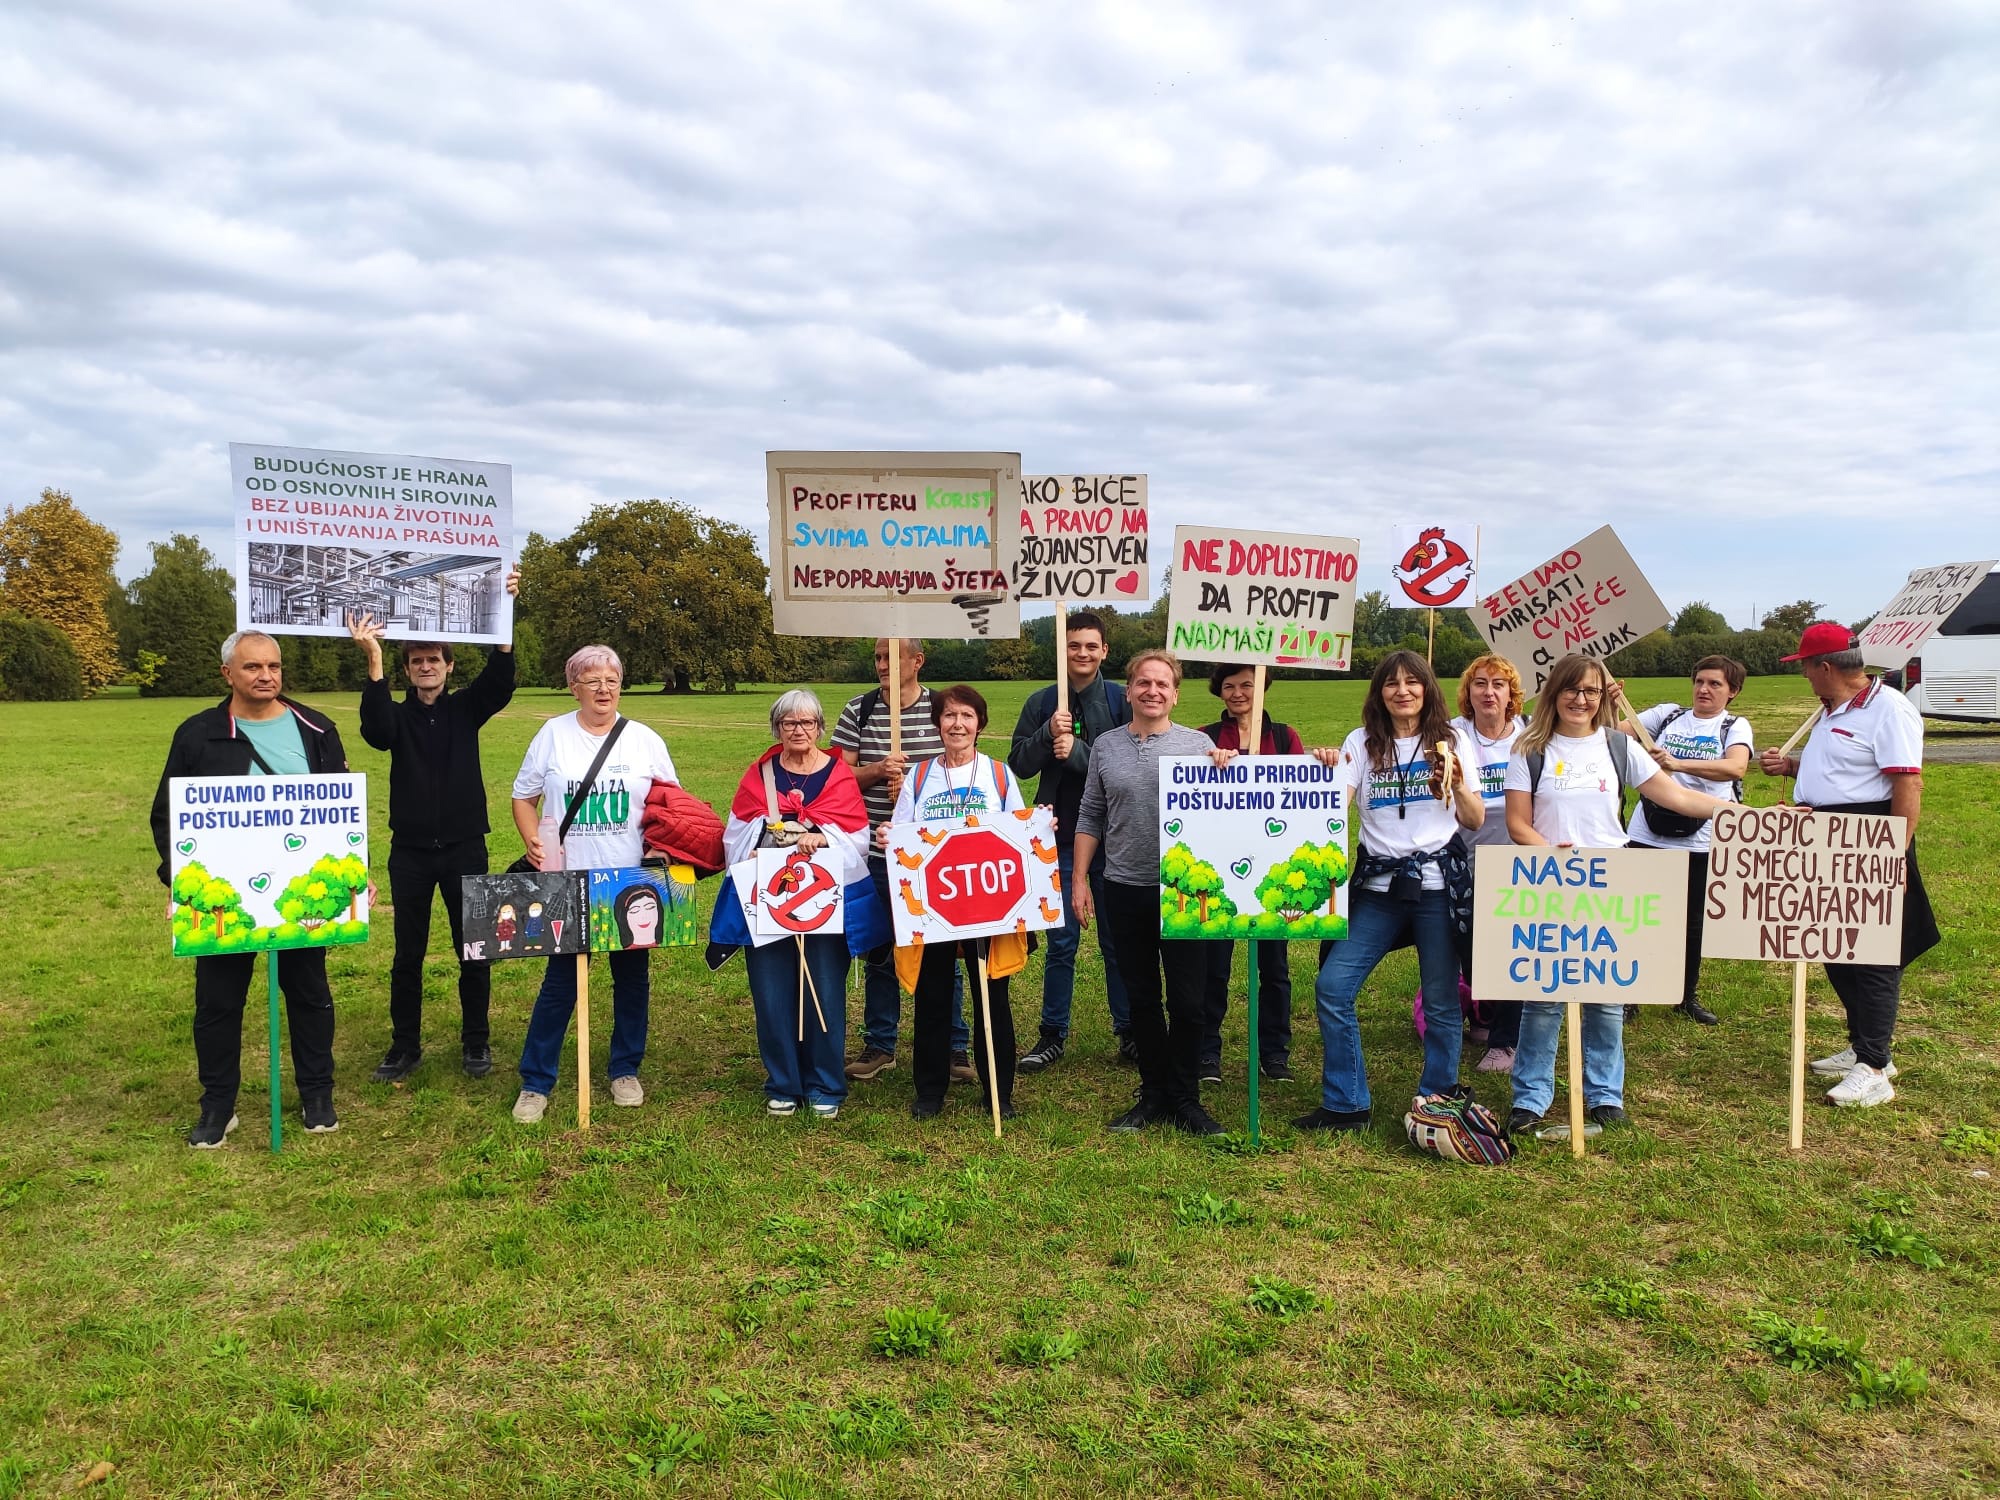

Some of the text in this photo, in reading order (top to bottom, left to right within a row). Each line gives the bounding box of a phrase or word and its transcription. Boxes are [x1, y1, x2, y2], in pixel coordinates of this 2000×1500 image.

[254, 456, 488, 488] BUDUĆNOST JE HRANA
[245, 477, 497, 508] OD OSNOVNIH SIROVINA
[793, 485, 995, 517] PROFITERU KORIST,
[1020, 475, 1139, 505] AKO BIĆE
[251, 498, 494, 528] BEZ UBIJANJA ŽIVOTINJA
[1020, 507, 1148, 535] A PRAVO NA
[246, 518, 500, 548] I UNIŠTAVANJA PRAŠUMA
[794, 519, 991, 548] SVIMA OSTALIMA
[1020, 535, 1148, 566] STOJANSTVEN
[1182, 539, 1358, 583] NE DOPUSTIMO
[1020, 566, 1117, 598] ŽIVOT
[1483, 550, 1582, 619] ŽELIMO
[1198, 581, 1339, 621] DA PROFIT
[1489, 573, 1584, 643] MIRISATI
[1532, 576, 1626, 640] CVIJEĆE
[1173, 619, 1351, 660] NADMAŠI ŽIVOT
[1564, 617, 1598, 650] NE
[1172, 762, 1334, 784] ČUVAMO PRIRODU
[185, 782, 353, 804] ČUVAMO PRIRODU
[1167, 787, 1341, 810] POŠTUJEMO ŽIVOTE
[179, 805, 361, 830] POŠTUJEMO ŽIVOTE
[1714, 809, 1896, 850] GOSPIĆ PLIVA
[938, 858, 1016, 900] STOP
[1512, 850, 1608, 888] NAŠE
[1711, 847, 1907, 889] U SMEĆU, FEKALIJE
[1493, 888, 1662, 934] ZDRAVLJE
[1707, 880, 1893, 925] S MEGAFARMI
[463, 941, 486, 960] NE
[1512, 923, 1618, 953] NEMA
[1760, 923, 1859, 960] NEĆU!
[1509, 956, 1639, 994] CIJENU
